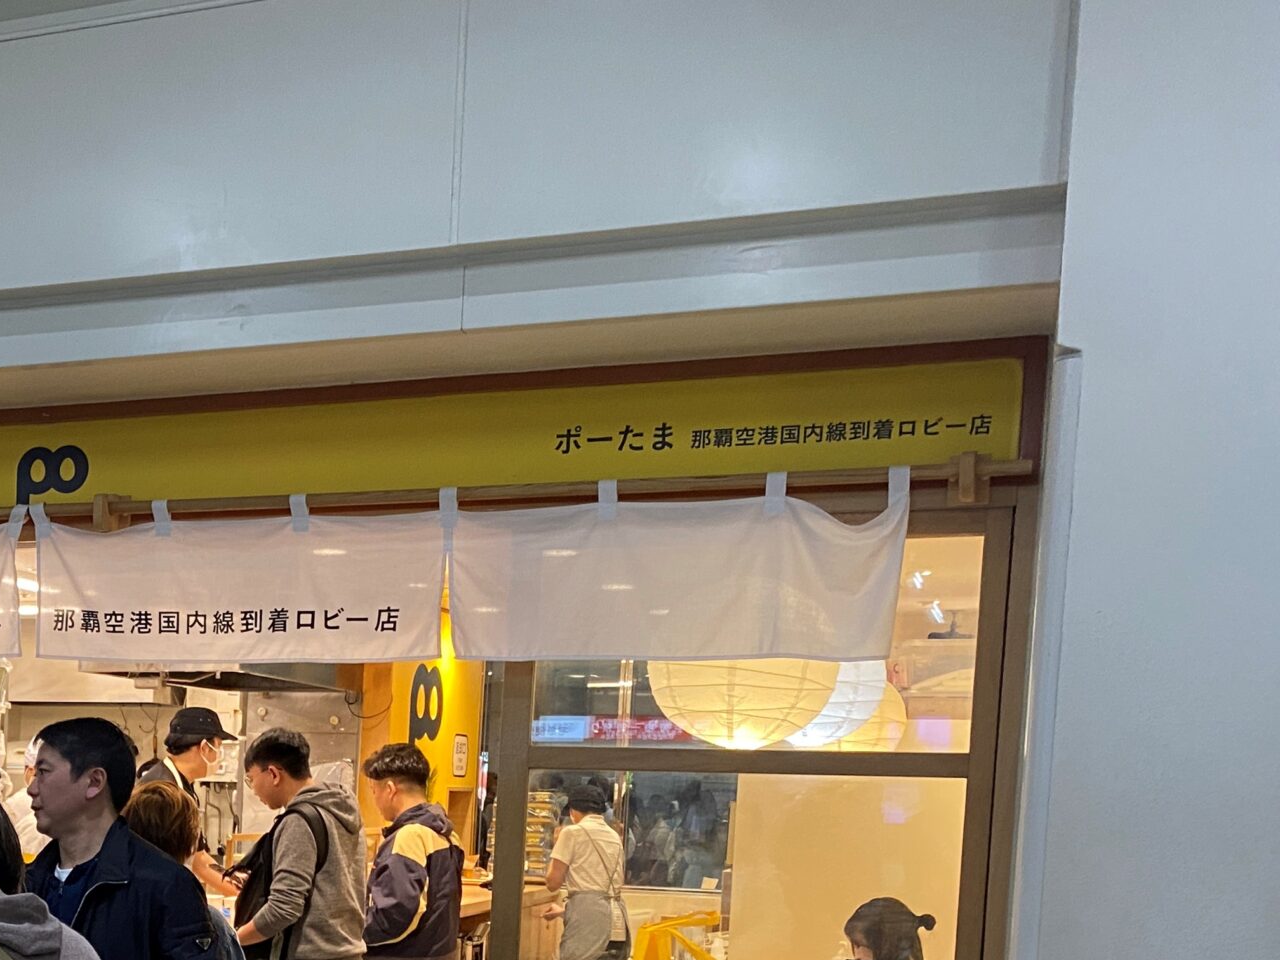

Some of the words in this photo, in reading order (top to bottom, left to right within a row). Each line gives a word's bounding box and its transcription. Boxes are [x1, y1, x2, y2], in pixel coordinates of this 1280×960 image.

[555, 422, 675, 454] ポーたま
[691, 414, 993, 449] 那覇空港国内線到着ロビー店
[53, 606, 401, 635] 那覇空港国内線到着ロビー店
